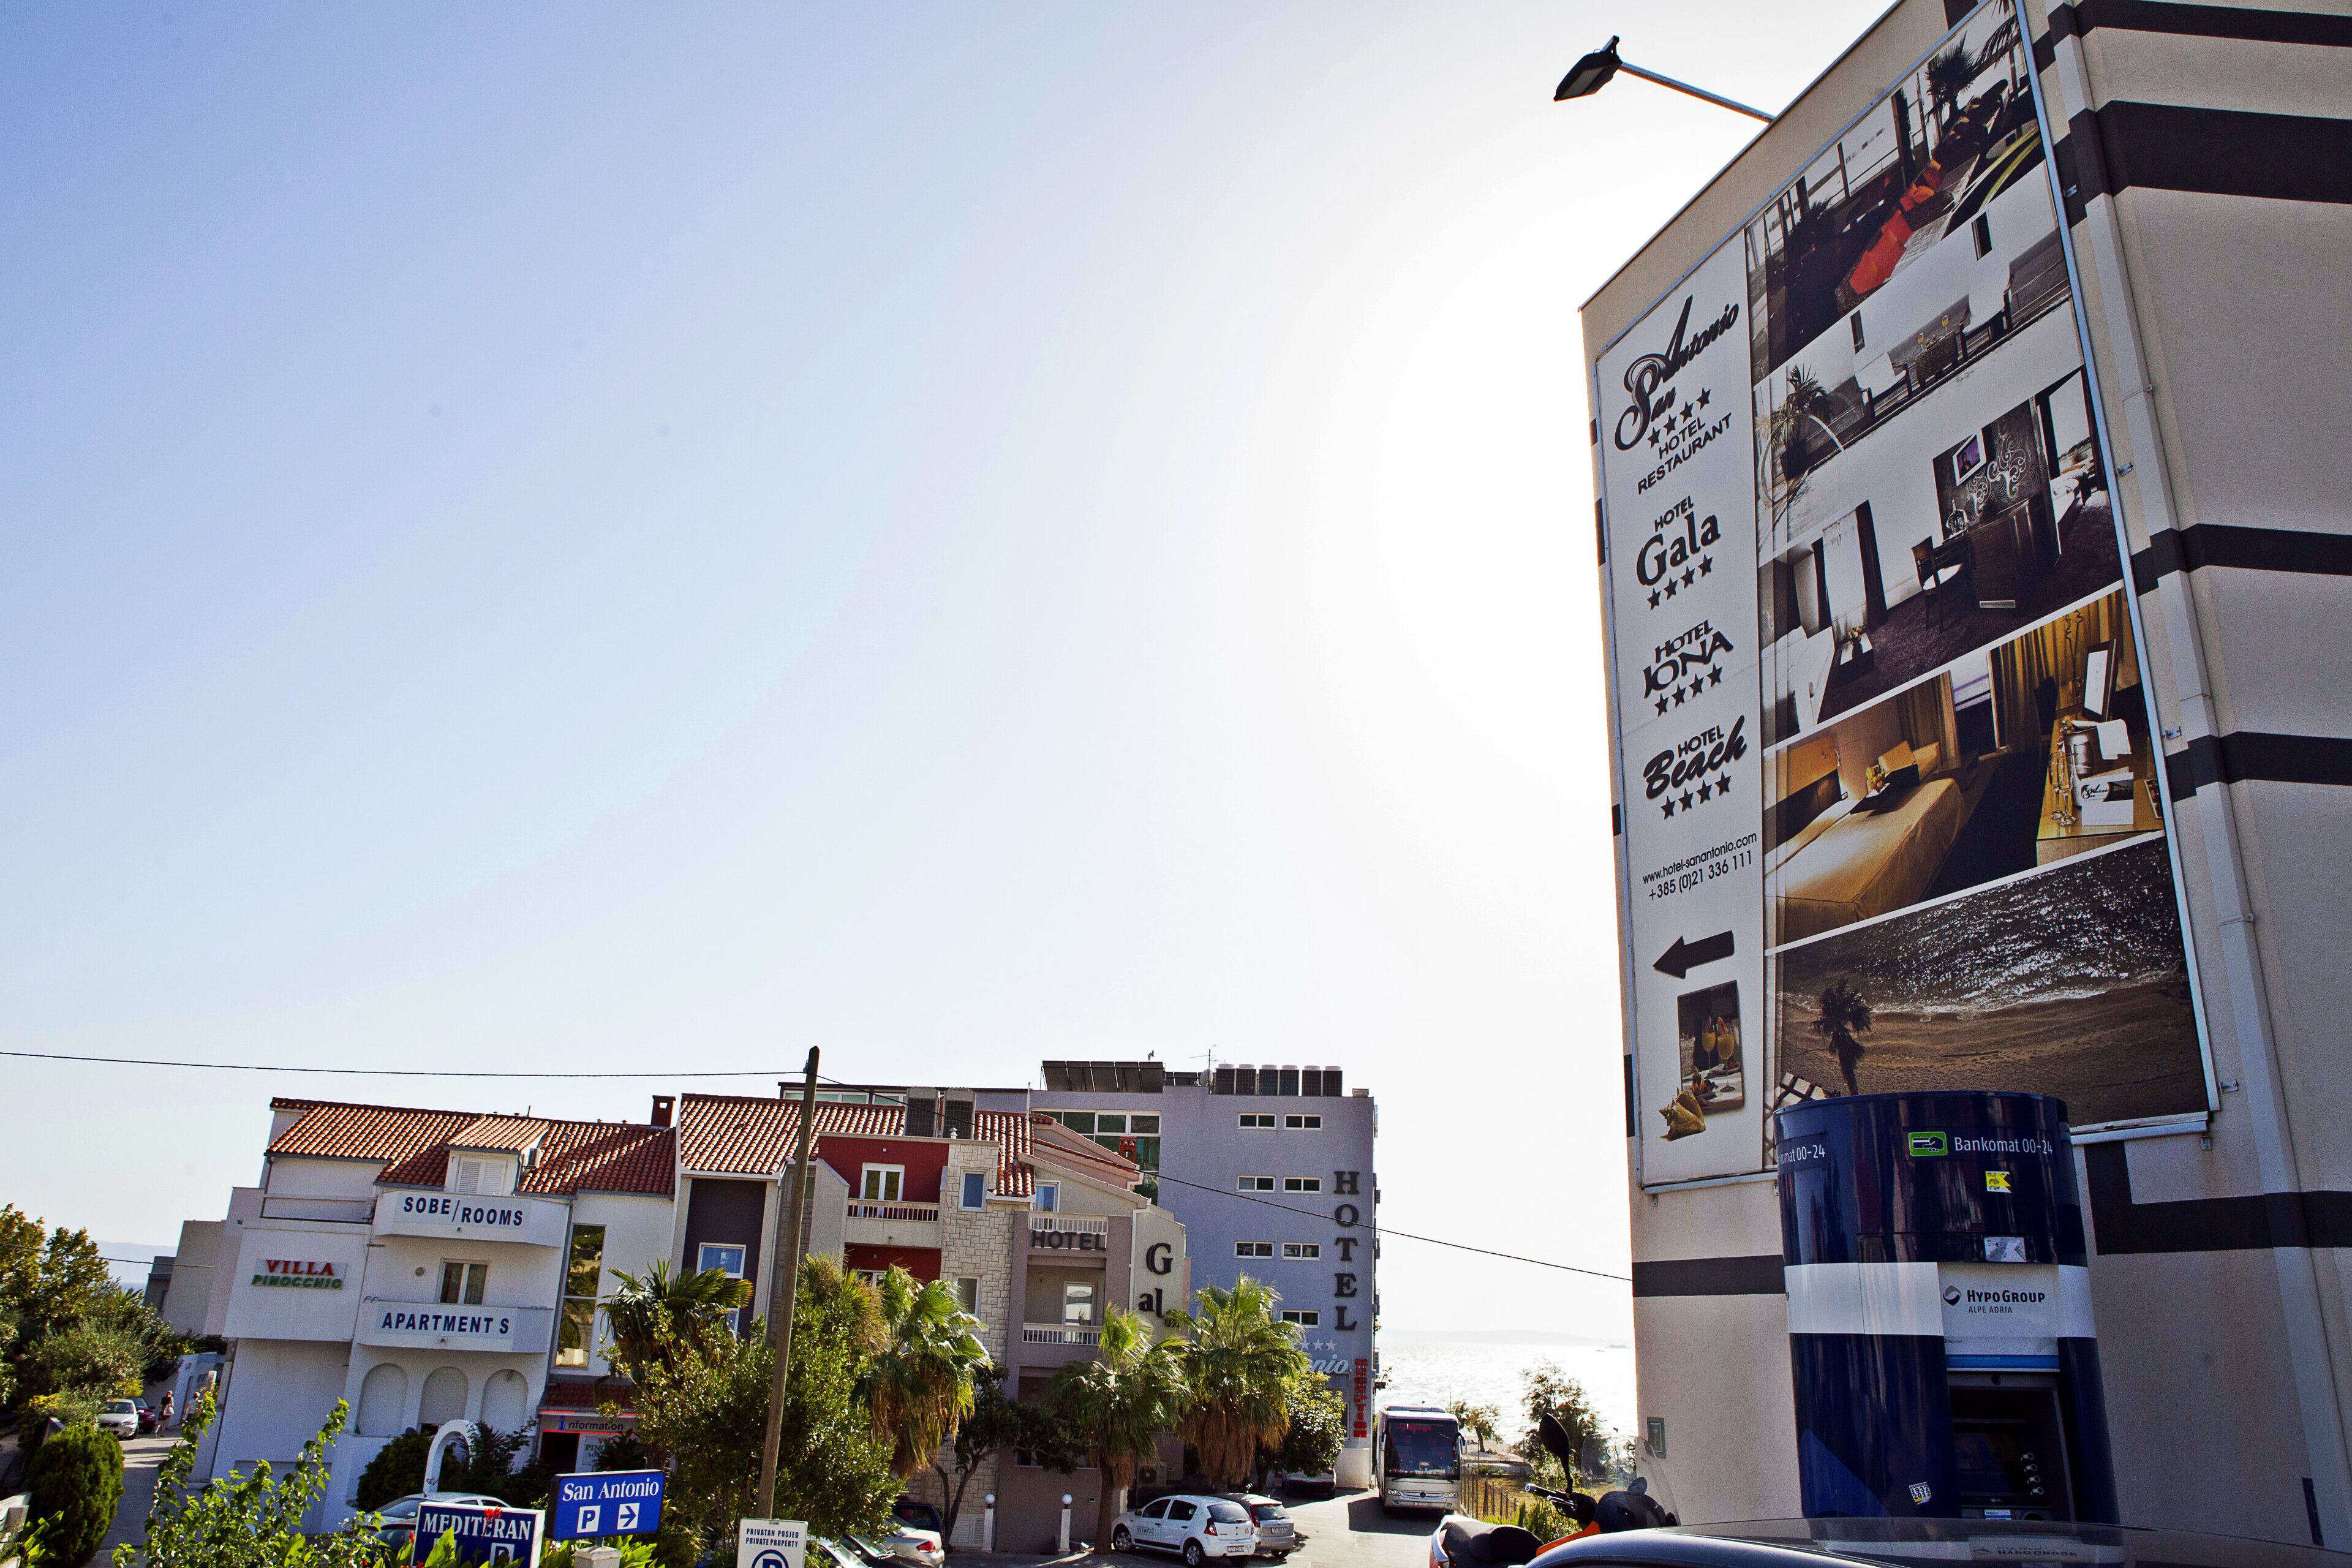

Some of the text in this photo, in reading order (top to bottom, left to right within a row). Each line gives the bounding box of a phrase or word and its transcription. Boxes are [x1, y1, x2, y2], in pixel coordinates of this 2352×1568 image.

[1662, 294, 1740, 383] Antonio
[1615, 353, 1676, 451] San
[1637, 412, 1732, 495] RESTAURANT
[1659, 417, 1706, 460] HOTEL
[1654, 496, 1694, 532] HOTEL
[1637, 511, 1721, 586] Gala
[1654, 619, 1713, 663] HOTEL
[1643, 630, 1734, 699] IONA
[1643, 715, 1747, 800] Beach
[1678, 725, 1724, 758] HOTEL
[1642, 832, 1757, 884] www.hotel-sanantonio.com
[1649, 850, 1752, 900] +385 (0)21 336 111
[1796, 1144, 1825, 1161] 00-24
[1954, 1136, 2053, 1155] Bankomat 00-24
[1031, 1230, 1106, 1251] HOTEL
[1333, 1171, 1360, 1331] HOTEL
[251, 1274, 344, 1290] PINOCCHIO
[266, 1259, 335, 1276] VILLA
[562, 1477, 659, 1502] San Antonio
[423, 1513, 532, 1540] MEDITERAN
[581, 1510, 596, 1529] P
[746, 1528, 775, 1537] PRIVATAN
[770, 1539, 799, 1547] PROPERTY
